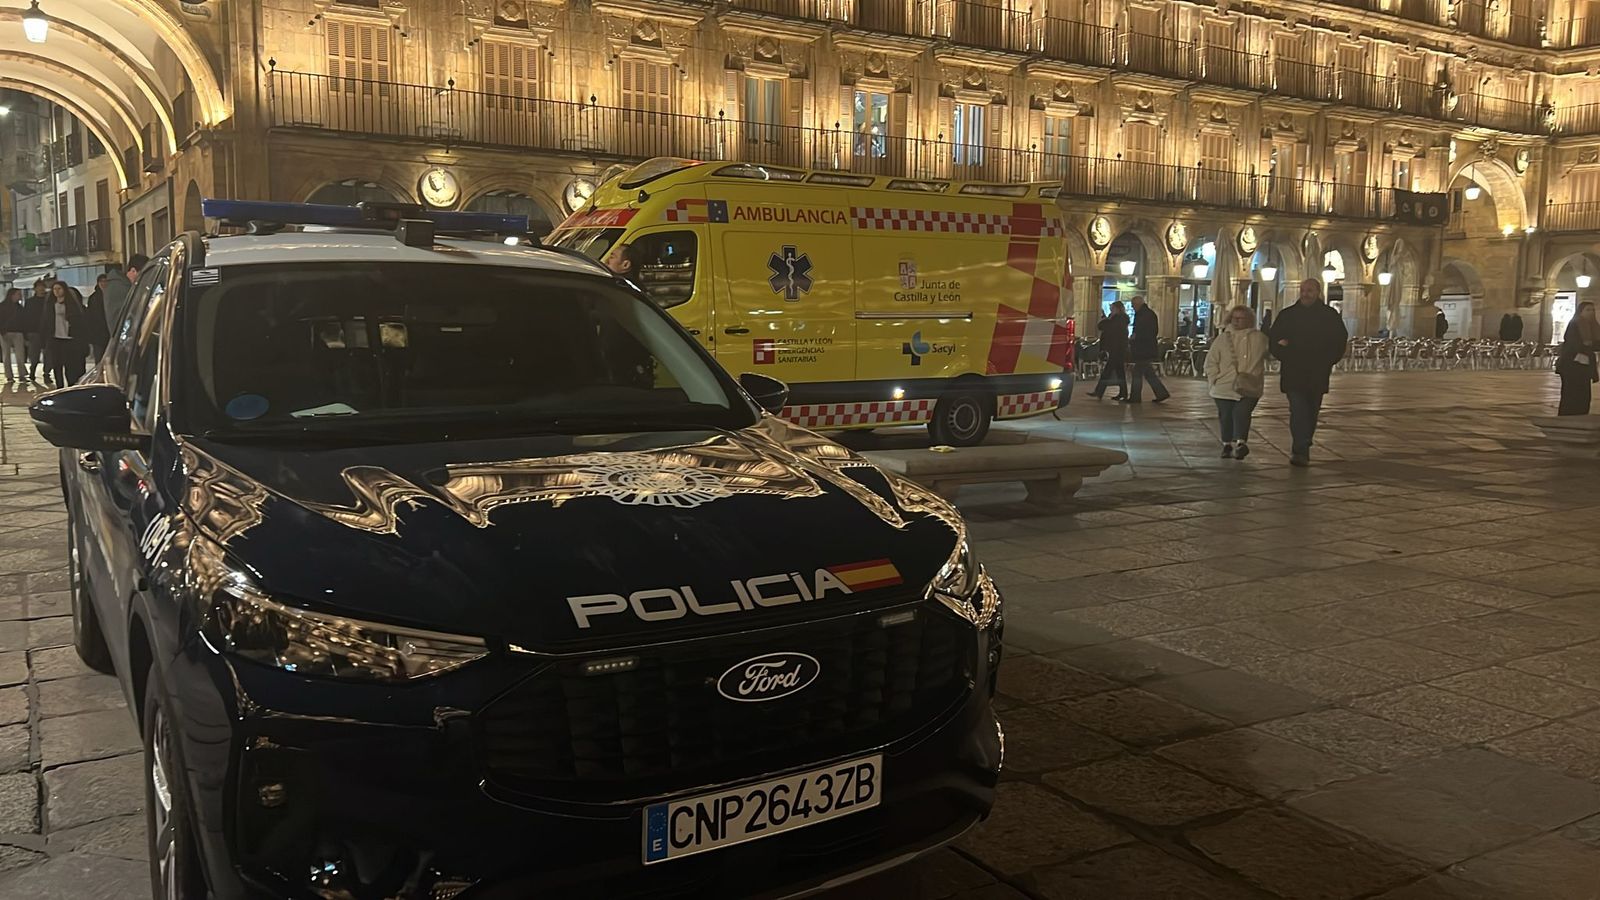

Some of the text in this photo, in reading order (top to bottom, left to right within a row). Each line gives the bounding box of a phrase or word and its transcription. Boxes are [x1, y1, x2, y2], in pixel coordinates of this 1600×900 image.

[733, 206, 848, 224] AMBULANCIA
[920, 279, 961, 290] Junta de
[894, 291, 961, 304] Castilla y León
[931, 343, 956, 355] Sacyl
[778, 355, 817, 363] SANITARIAS
[738, 660, 802, 696] Ford
[652, 762, 875, 852] E CNP2643ZB
